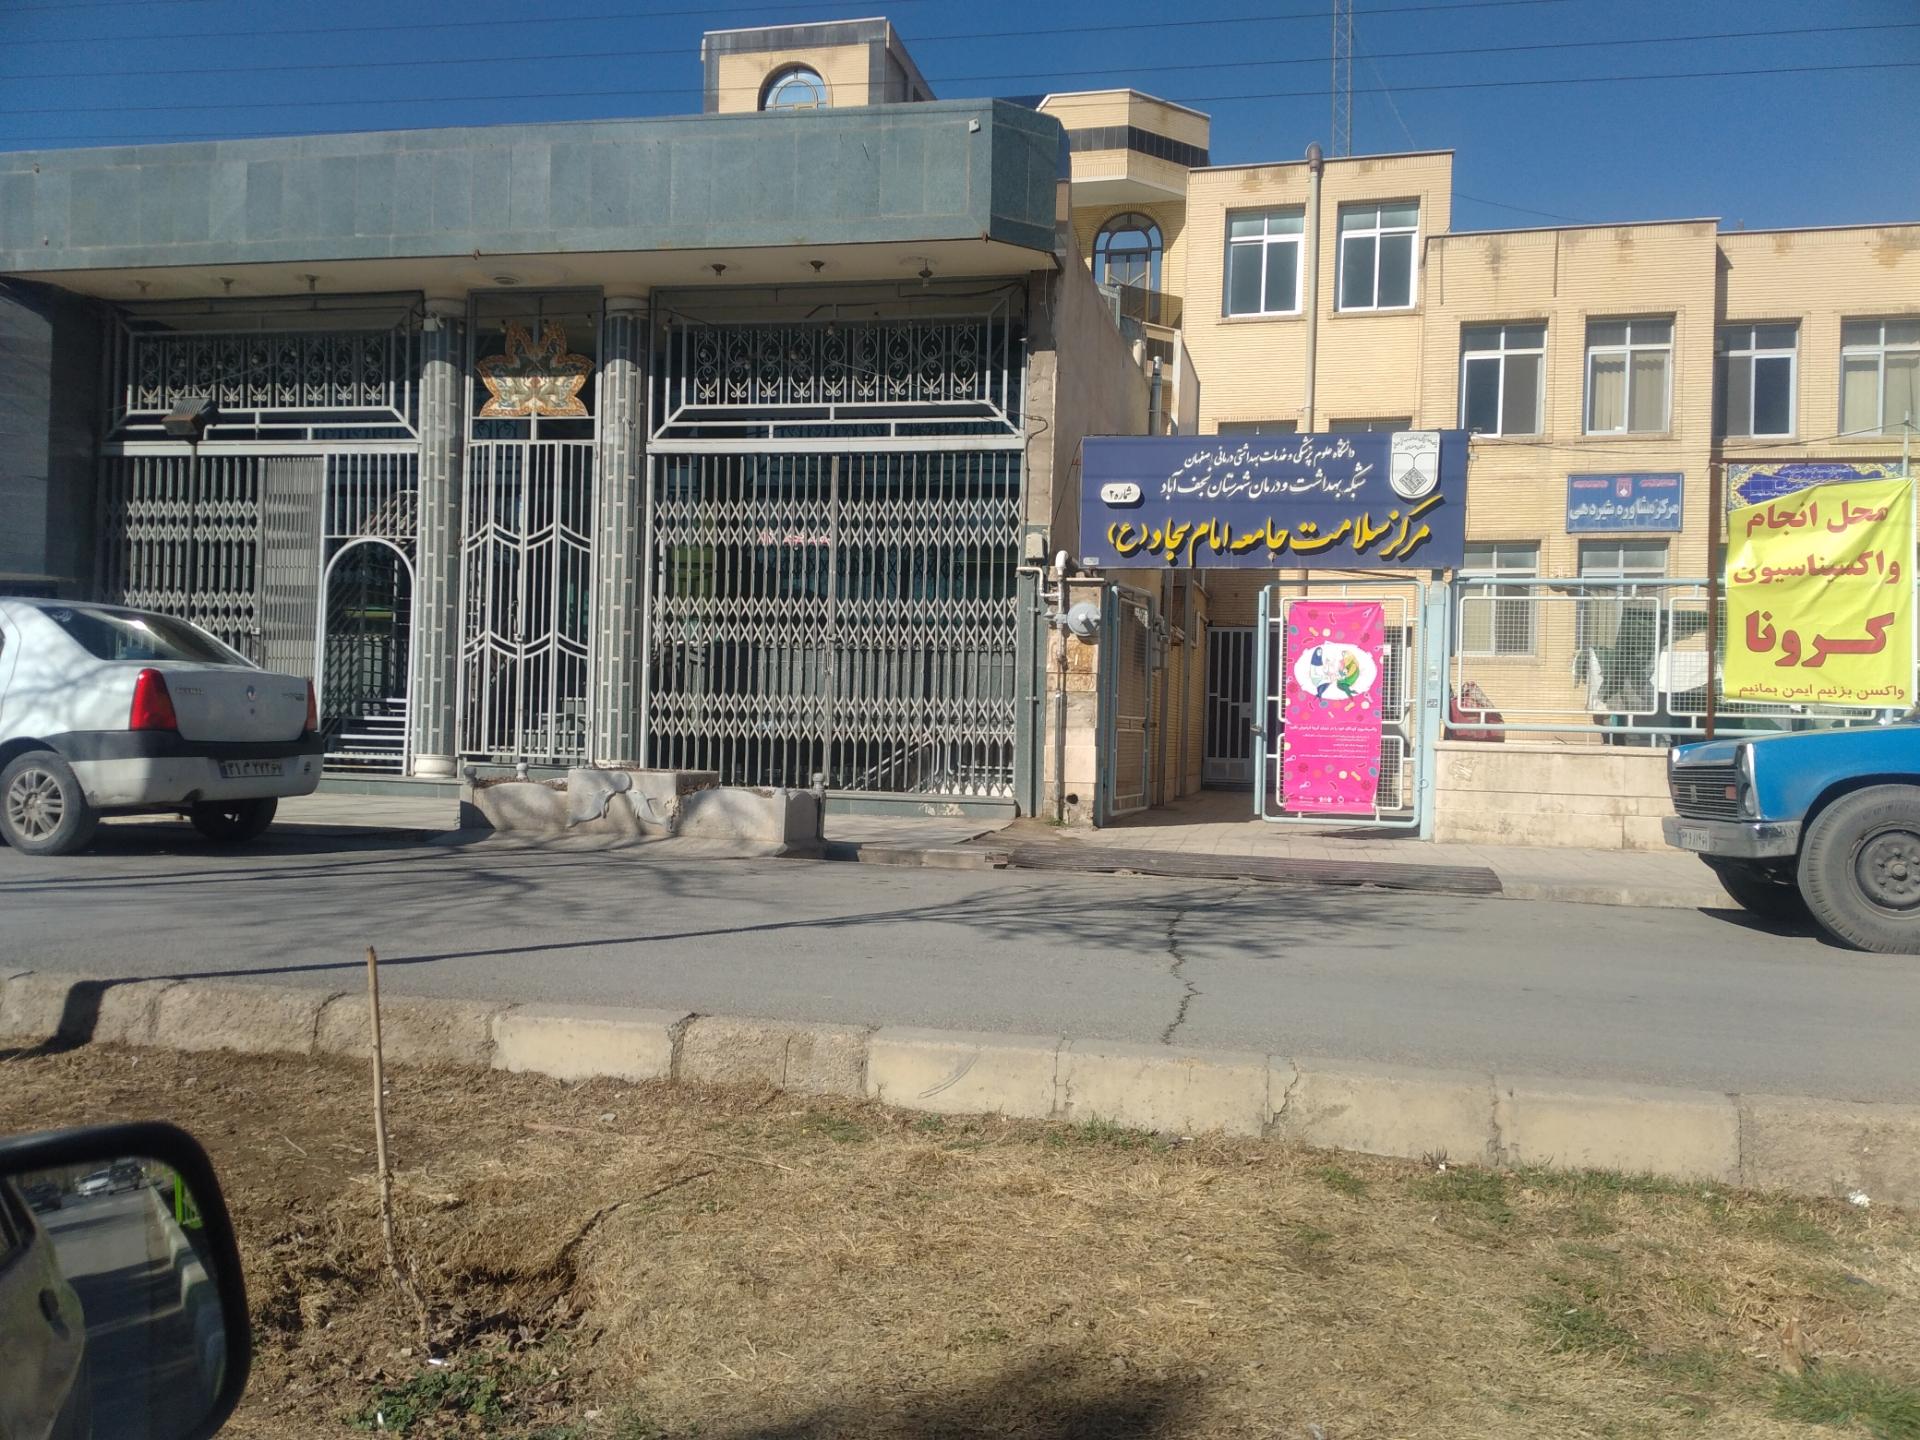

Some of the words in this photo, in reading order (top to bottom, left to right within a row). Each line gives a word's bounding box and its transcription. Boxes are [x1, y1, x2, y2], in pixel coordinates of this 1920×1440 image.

[1184, 450, 1213, 468] اصفهان
[1213, 446, 1233, 466] درمانی
[1233, 443, 1260, 467] بهداشتی
[1260, 448, 1287, 461] خدمات
[1293, 436, 1314, 466] پزشکی
[1313, 446, 1332, 467] علوم
[1332, 438, 1355, 458] دانشگاه
[1160, 469, 1184, 500] آباد
[1178, 467, 1212, 497] نجف
[1207, 470, 1251, 498] شهرستان
[1249, 477, 1280, 498] درمان
[1280, 482, 1289, 492] و
[1289, 468, 1343, 498] بهداشت
[1343, 462, 1373, 499] شبکه
[1616, 495, 1654, 520] مشاوره
[1653, 498, 1679, 520] مرکز
[1747, 501, 1818, 538] انجام
[1827, 499, 1889, 533] محل
[1230, 516, 1289, 553] جامعه
[1290, 512, 1390, 550] سلامت
[1378, 495, 1442, 557] مرکز
[1188, 517, 1229, 567] امام
[1733, 550, 1901, 585] واکسیناسیون
[1746, 610, 1896, 668] کرونا
[1739, 683, 1778, 698] بمانیم
[1782, 684, 1813, 698] ایمن
[1817, 686, 1852, 700] بزنیم
[1856, 685, 1905, 700] واکسن
